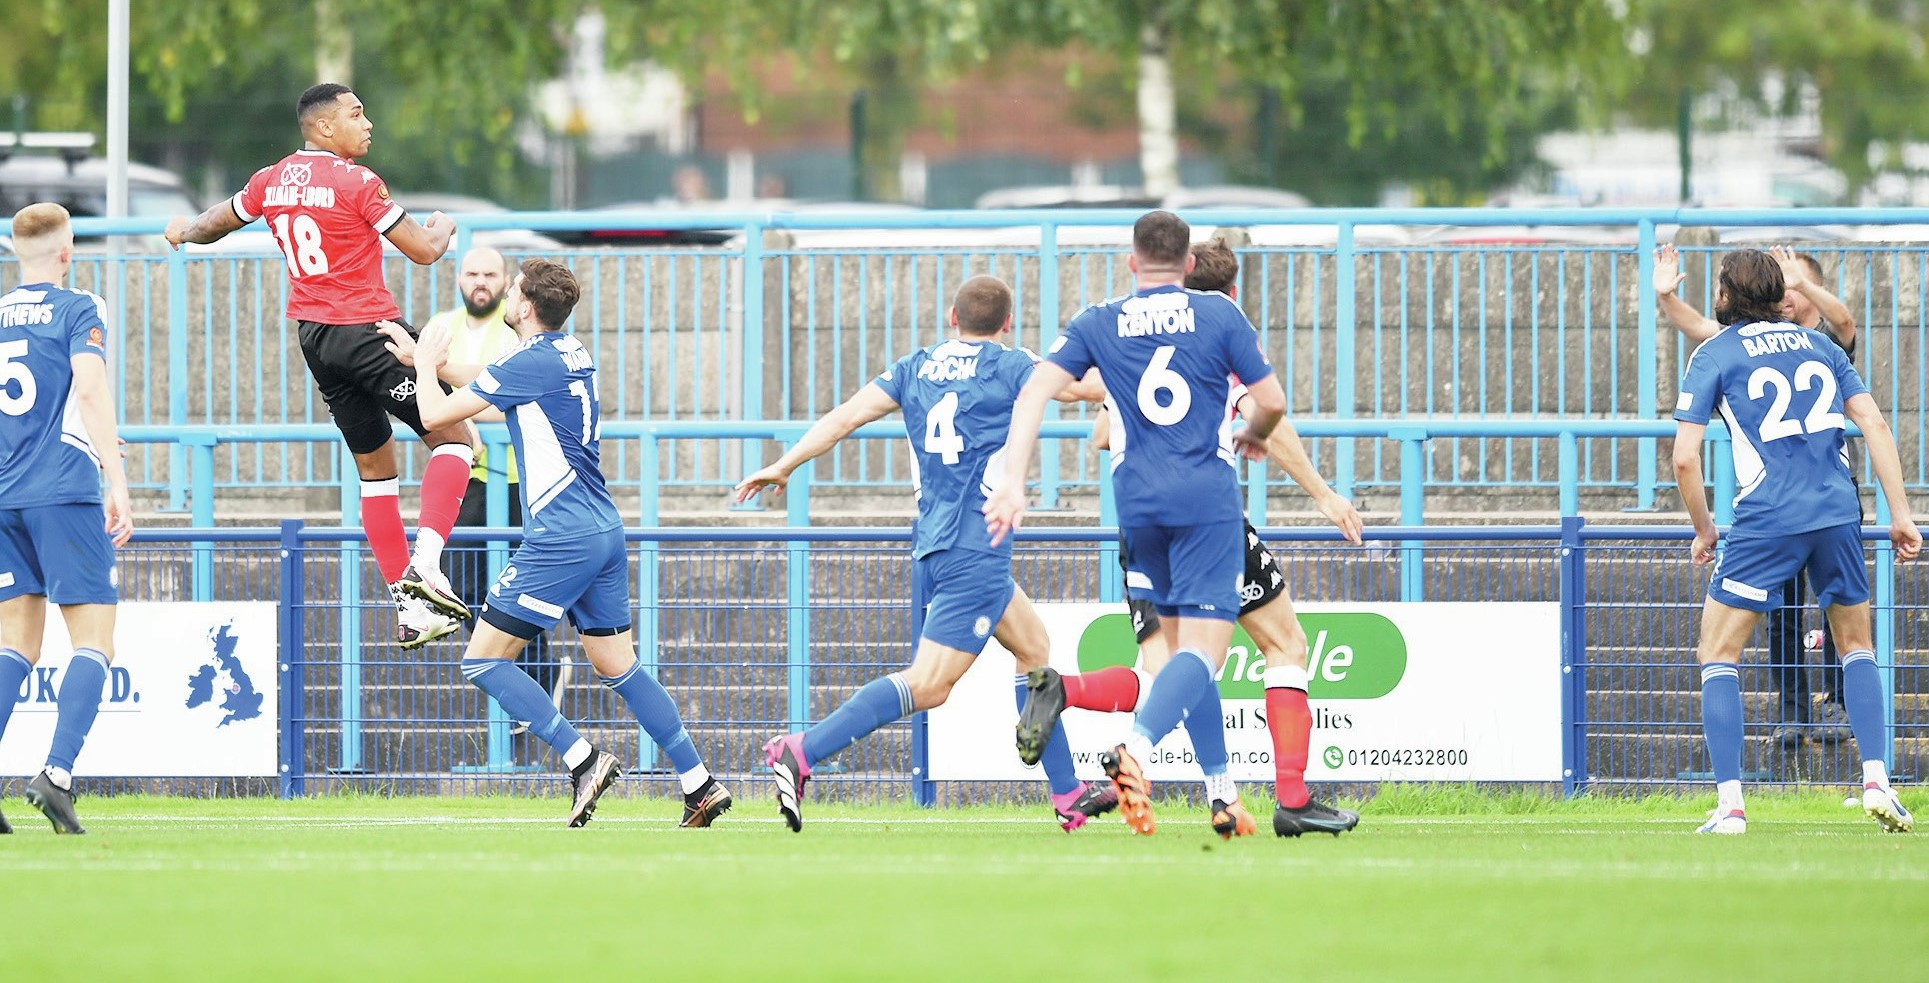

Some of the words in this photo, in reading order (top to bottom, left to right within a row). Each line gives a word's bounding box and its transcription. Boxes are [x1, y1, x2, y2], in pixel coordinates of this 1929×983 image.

[273, 213, 329, 278] 18
[0, 303, 54, 329] THEWS
[1118, 308, 1195, 338] KENYON
[1741, 332, 1814, 358] BARTON
[0, 339, 37, 416] 5
[1137, 345, 1191, 426] 6
[1747, 360, 1845, 443] 22
[924, 391, 965, 465] 4
[1254, 707, 1353, 729] Slies
[1348, 749, 1468, 766] 01204232800
